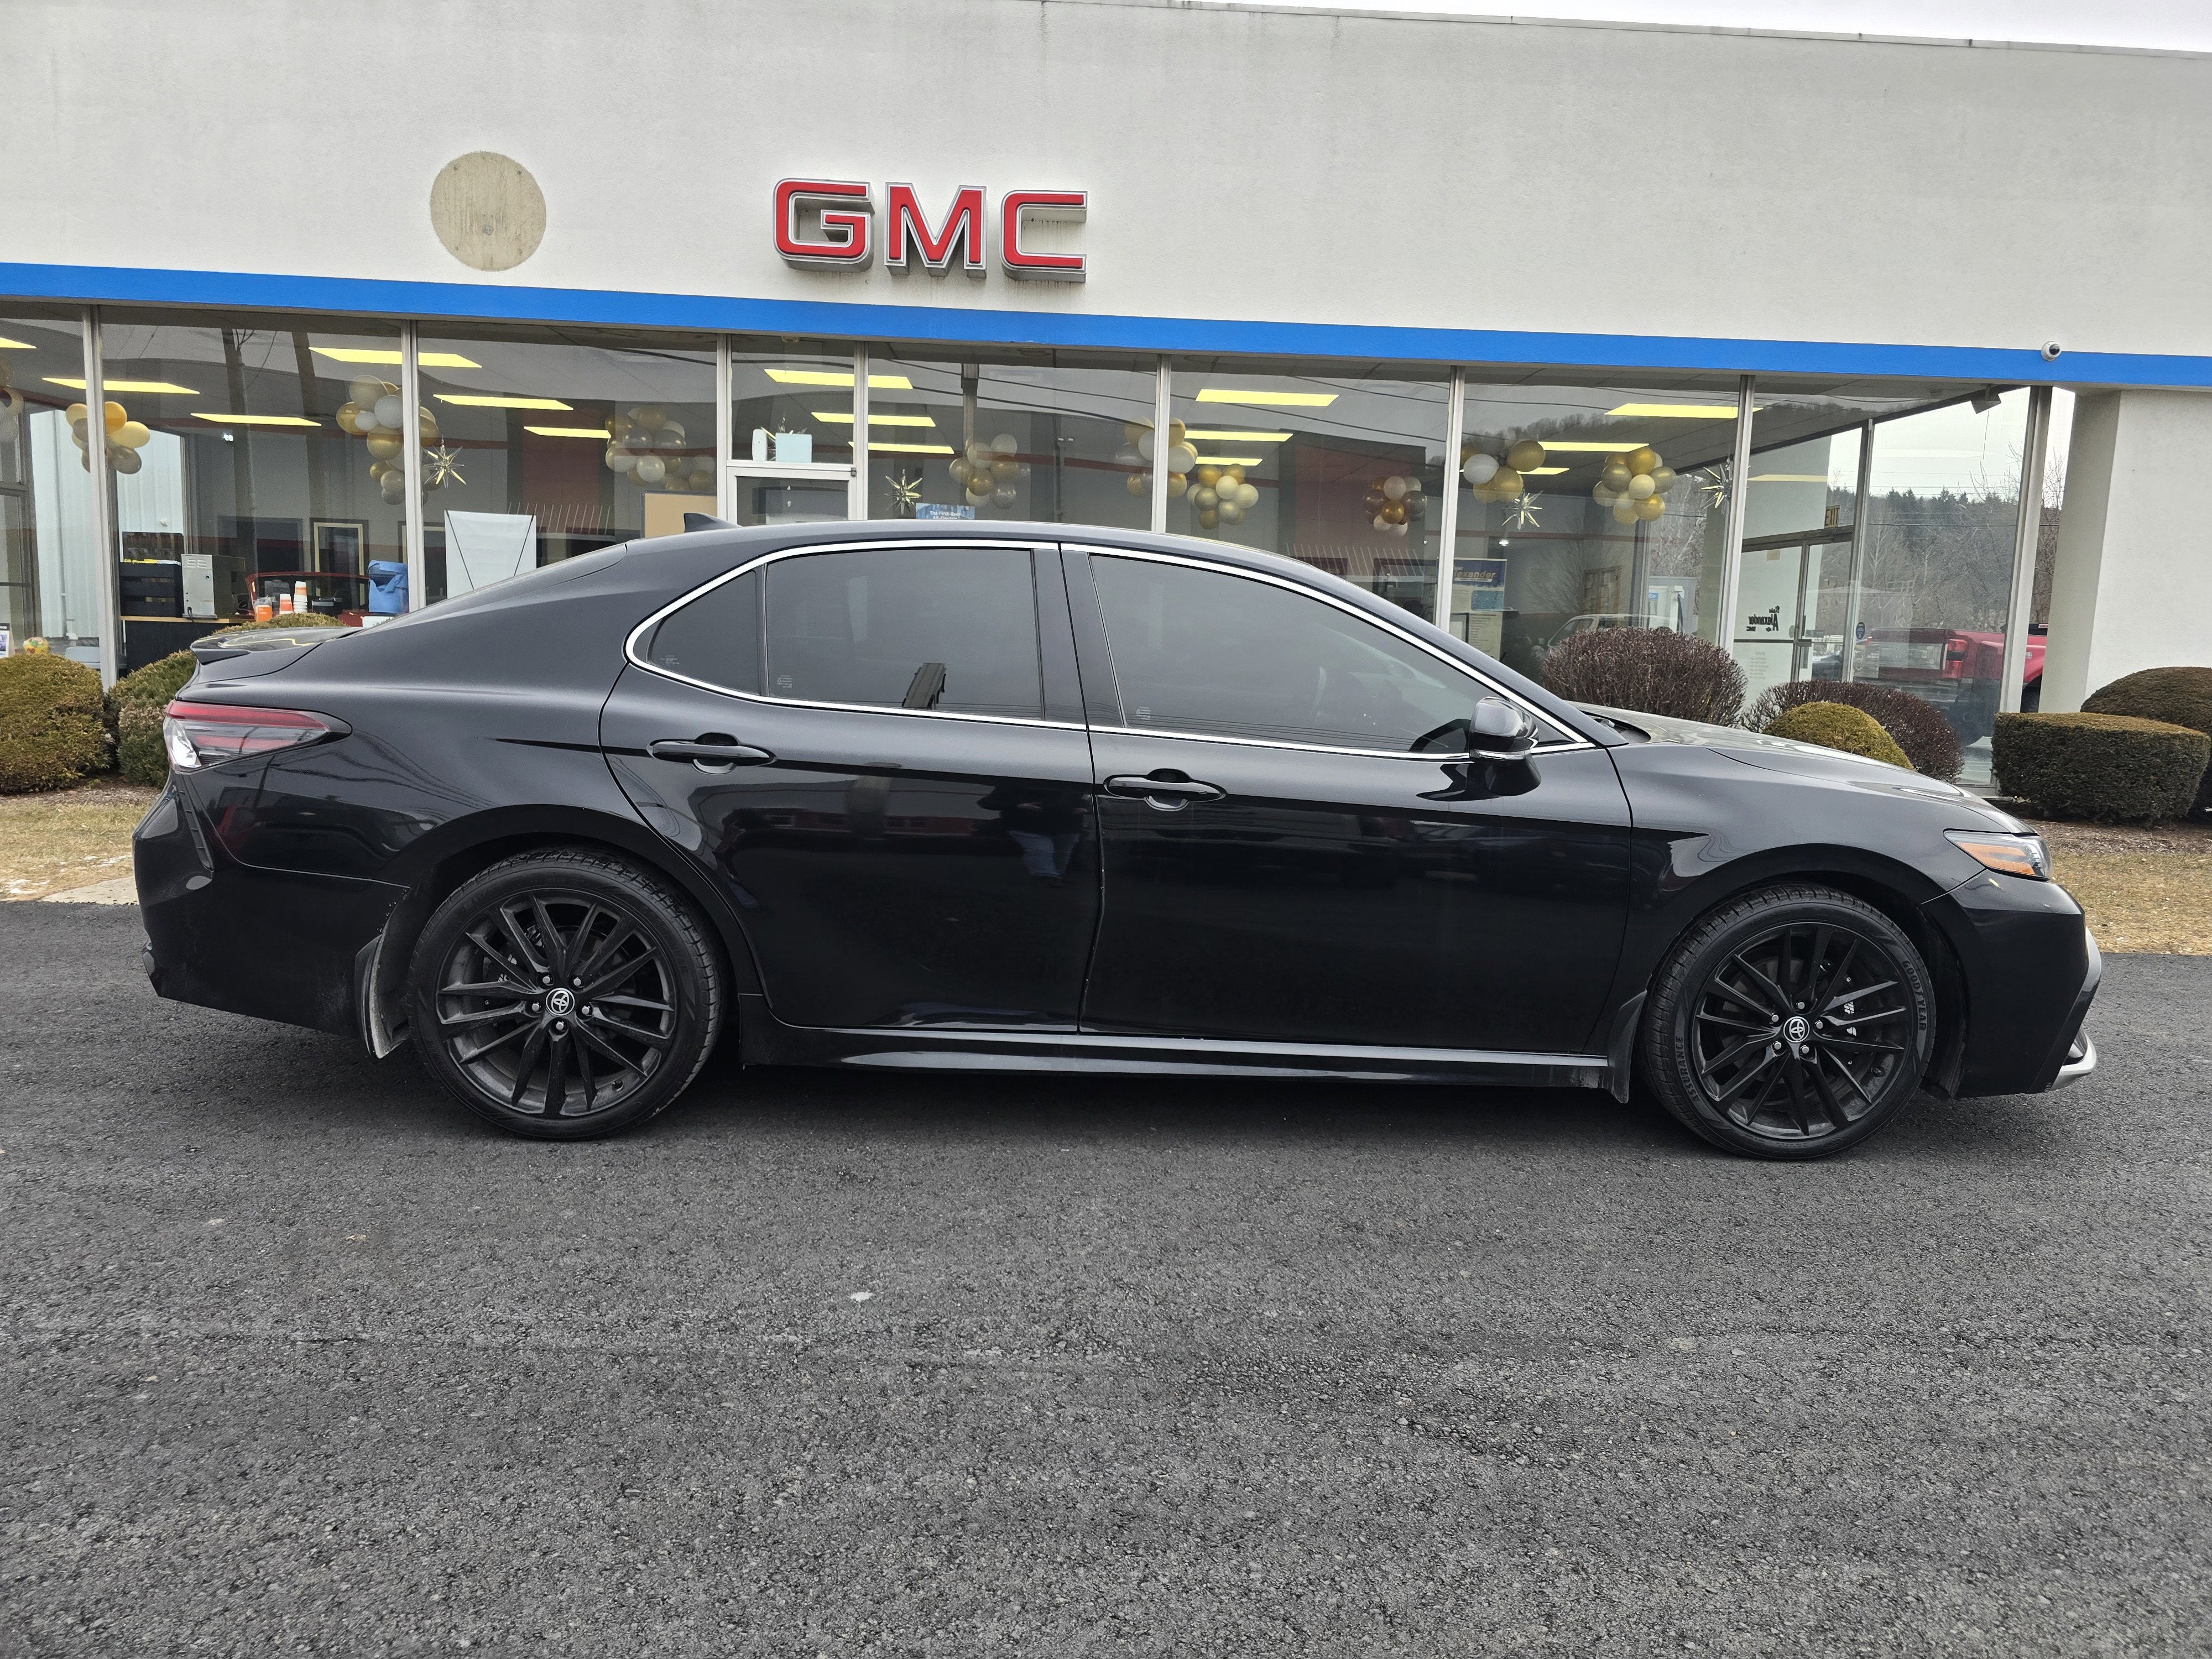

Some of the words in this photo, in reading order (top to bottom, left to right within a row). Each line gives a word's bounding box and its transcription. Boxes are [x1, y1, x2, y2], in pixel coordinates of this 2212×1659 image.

[774, 178, 1088, 278] GMC
[1824, 507, 1840, 526] EXIT
[1454, 570, 1496, 578] lexander
[1675, 1036, 1701, 1102] ASSURANCE
